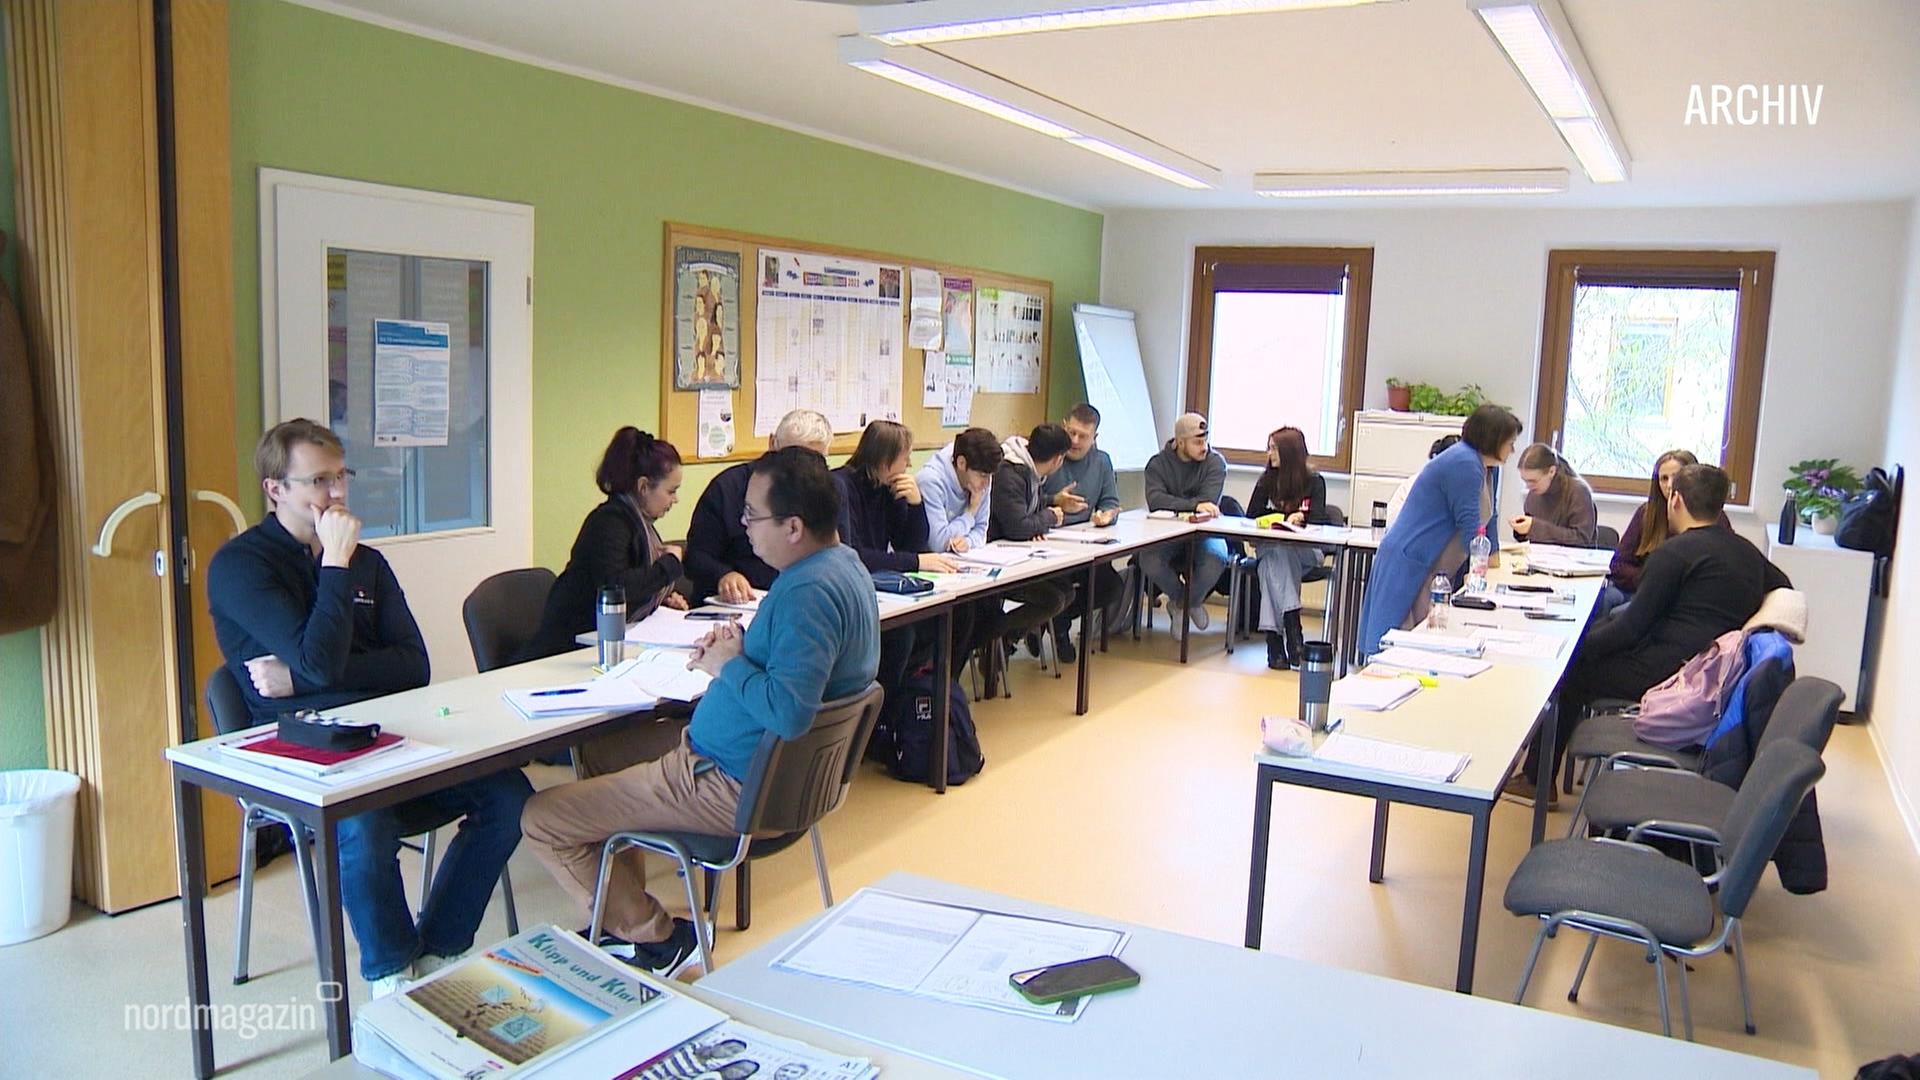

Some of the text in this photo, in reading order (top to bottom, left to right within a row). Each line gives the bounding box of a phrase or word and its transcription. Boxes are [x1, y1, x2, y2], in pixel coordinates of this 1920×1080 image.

[527, 933, 569, 965] Klipp
[570, 964, 602, 982] und
[599, 976, 635, 1003] Klar
